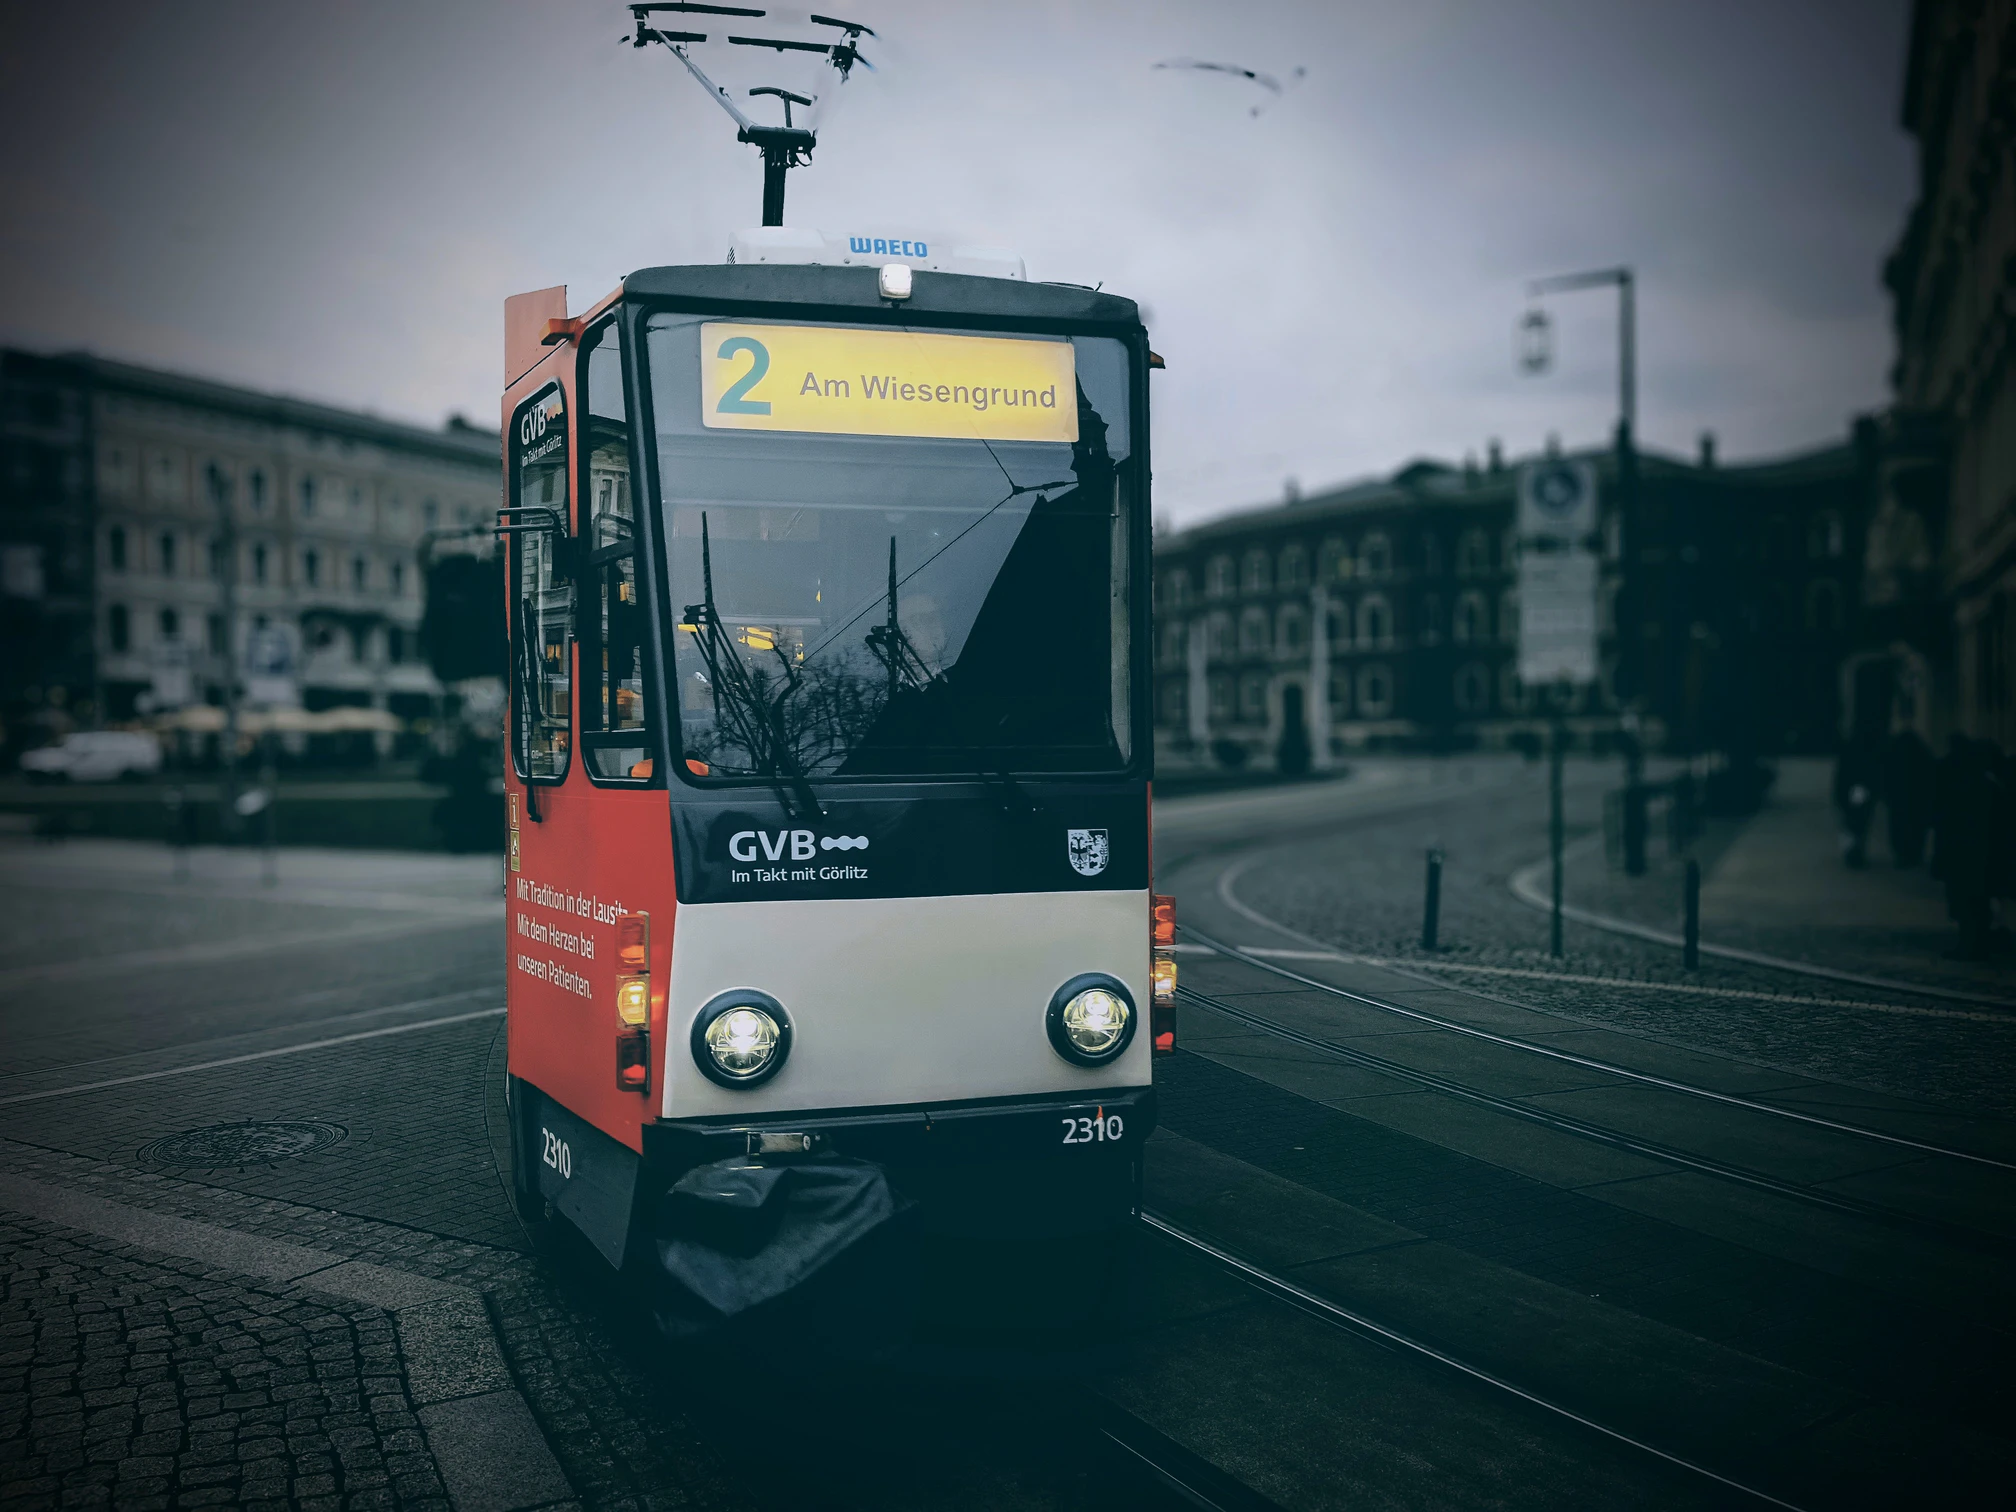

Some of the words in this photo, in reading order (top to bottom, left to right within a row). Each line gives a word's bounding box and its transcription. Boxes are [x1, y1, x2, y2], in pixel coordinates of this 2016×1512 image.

[850, 237, 928, 257] WAECO
[716, 336, 771, 416] 2
[799, 372, 850, 398] Am
[861, 375, 1056, 410] Wiesengrund
[521, 404, 546, 445] GVB
[729, 829, 816, 862] GVB
[732, 869, 750, 882] Im
[754, 868, 787, 881] Takt
[791, 867, 816, 881] mit
[819, 866, 868, 880] Görlitz
[516, 877, 529, 901] Mit
[529, 880, 564, 911] Tradition
[566, 888, 574, 913] in
[577, 891, 591, 918] der
[517, 912, 529, 937] Mit
[531, 917, 547, 943] dem
[549, 922, 579, 954] Herzen
[581, 931, 594, 959] bei
[517, 954, 547, 980] unseren
[549, 960, 592, 999] Patienten.
[1062, 1115, 1123, 1143] 2310
[542, 1127, 571, 1179] 2310
